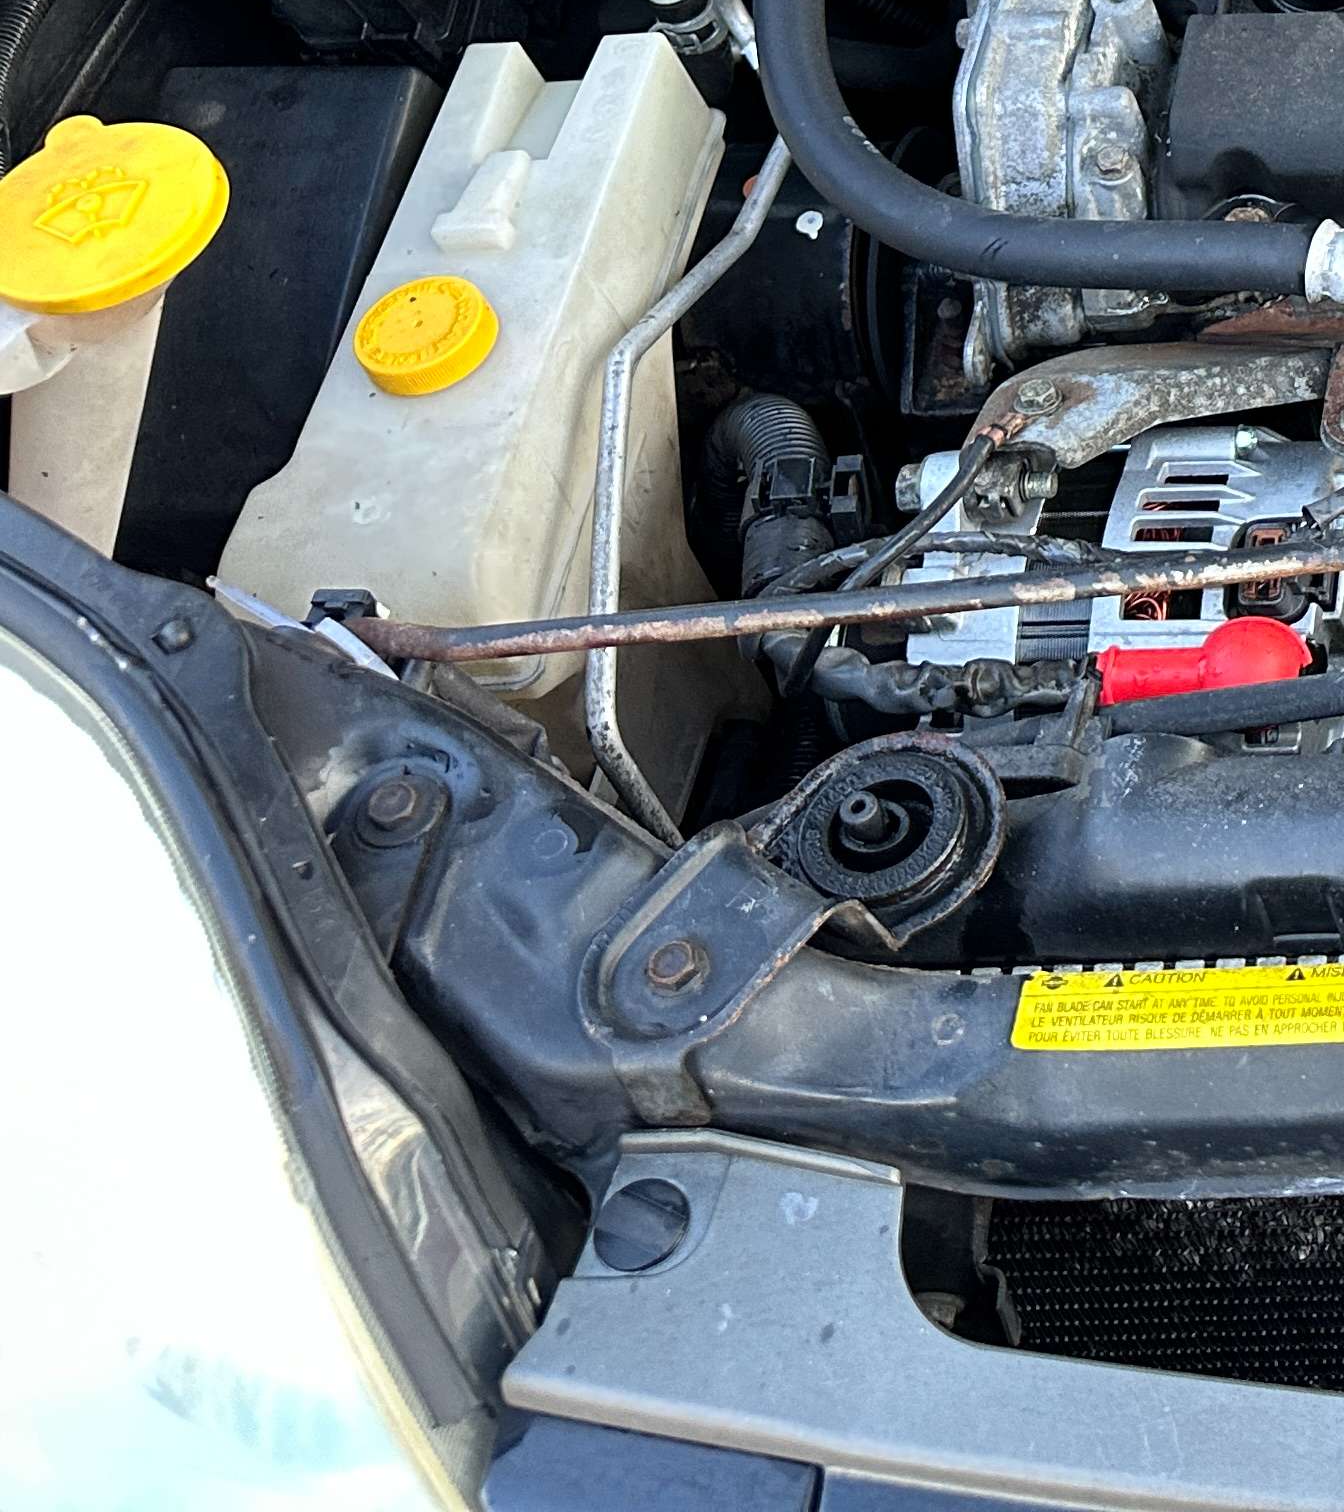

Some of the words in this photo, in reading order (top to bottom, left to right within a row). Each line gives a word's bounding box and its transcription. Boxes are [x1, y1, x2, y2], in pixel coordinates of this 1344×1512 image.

[1130, 973, 1207, 984] CAUTION
[1034, 1002, 1054, 1013] FAN
[1057, 1001, 1090, 1013] BLADE
[1093, 1000, 1113, 1011] CAN
[1117, 999, 1147, 1010] START
[1152, 998, 1166, 1009] AT
[1168, 998, 1188, 1009] ANY
[1239, 994, 1268, 1006] AVOID
[1273, 993, 1321, 1005] PERSONAL
[1031, 1016, 1045, 1028] LE
[1052, 1014, 1124, 1026] VENTILATEUR
[1129, 1013, 1168, 1025] RISQUE
[1172, 1012, 1186, 1023] DE
[1191, 1009, 1251, 1023] DÉMARRER
[1269, 1007, 1297, 1019] TOUT
[1028, 1031, 1058, 1043] POUR
[1062, 1028, 1101, 1042] ÉVITER
[1106, 1029, 1139, 1041] TOUTE
[1210, 1026, 1225, 1038] NE
[1229, 1025, 1249, 1037] PAS
[1254, 1024, 1268, 1035] EN
[1273, 1020, 1337, 1034] APPROCHER
